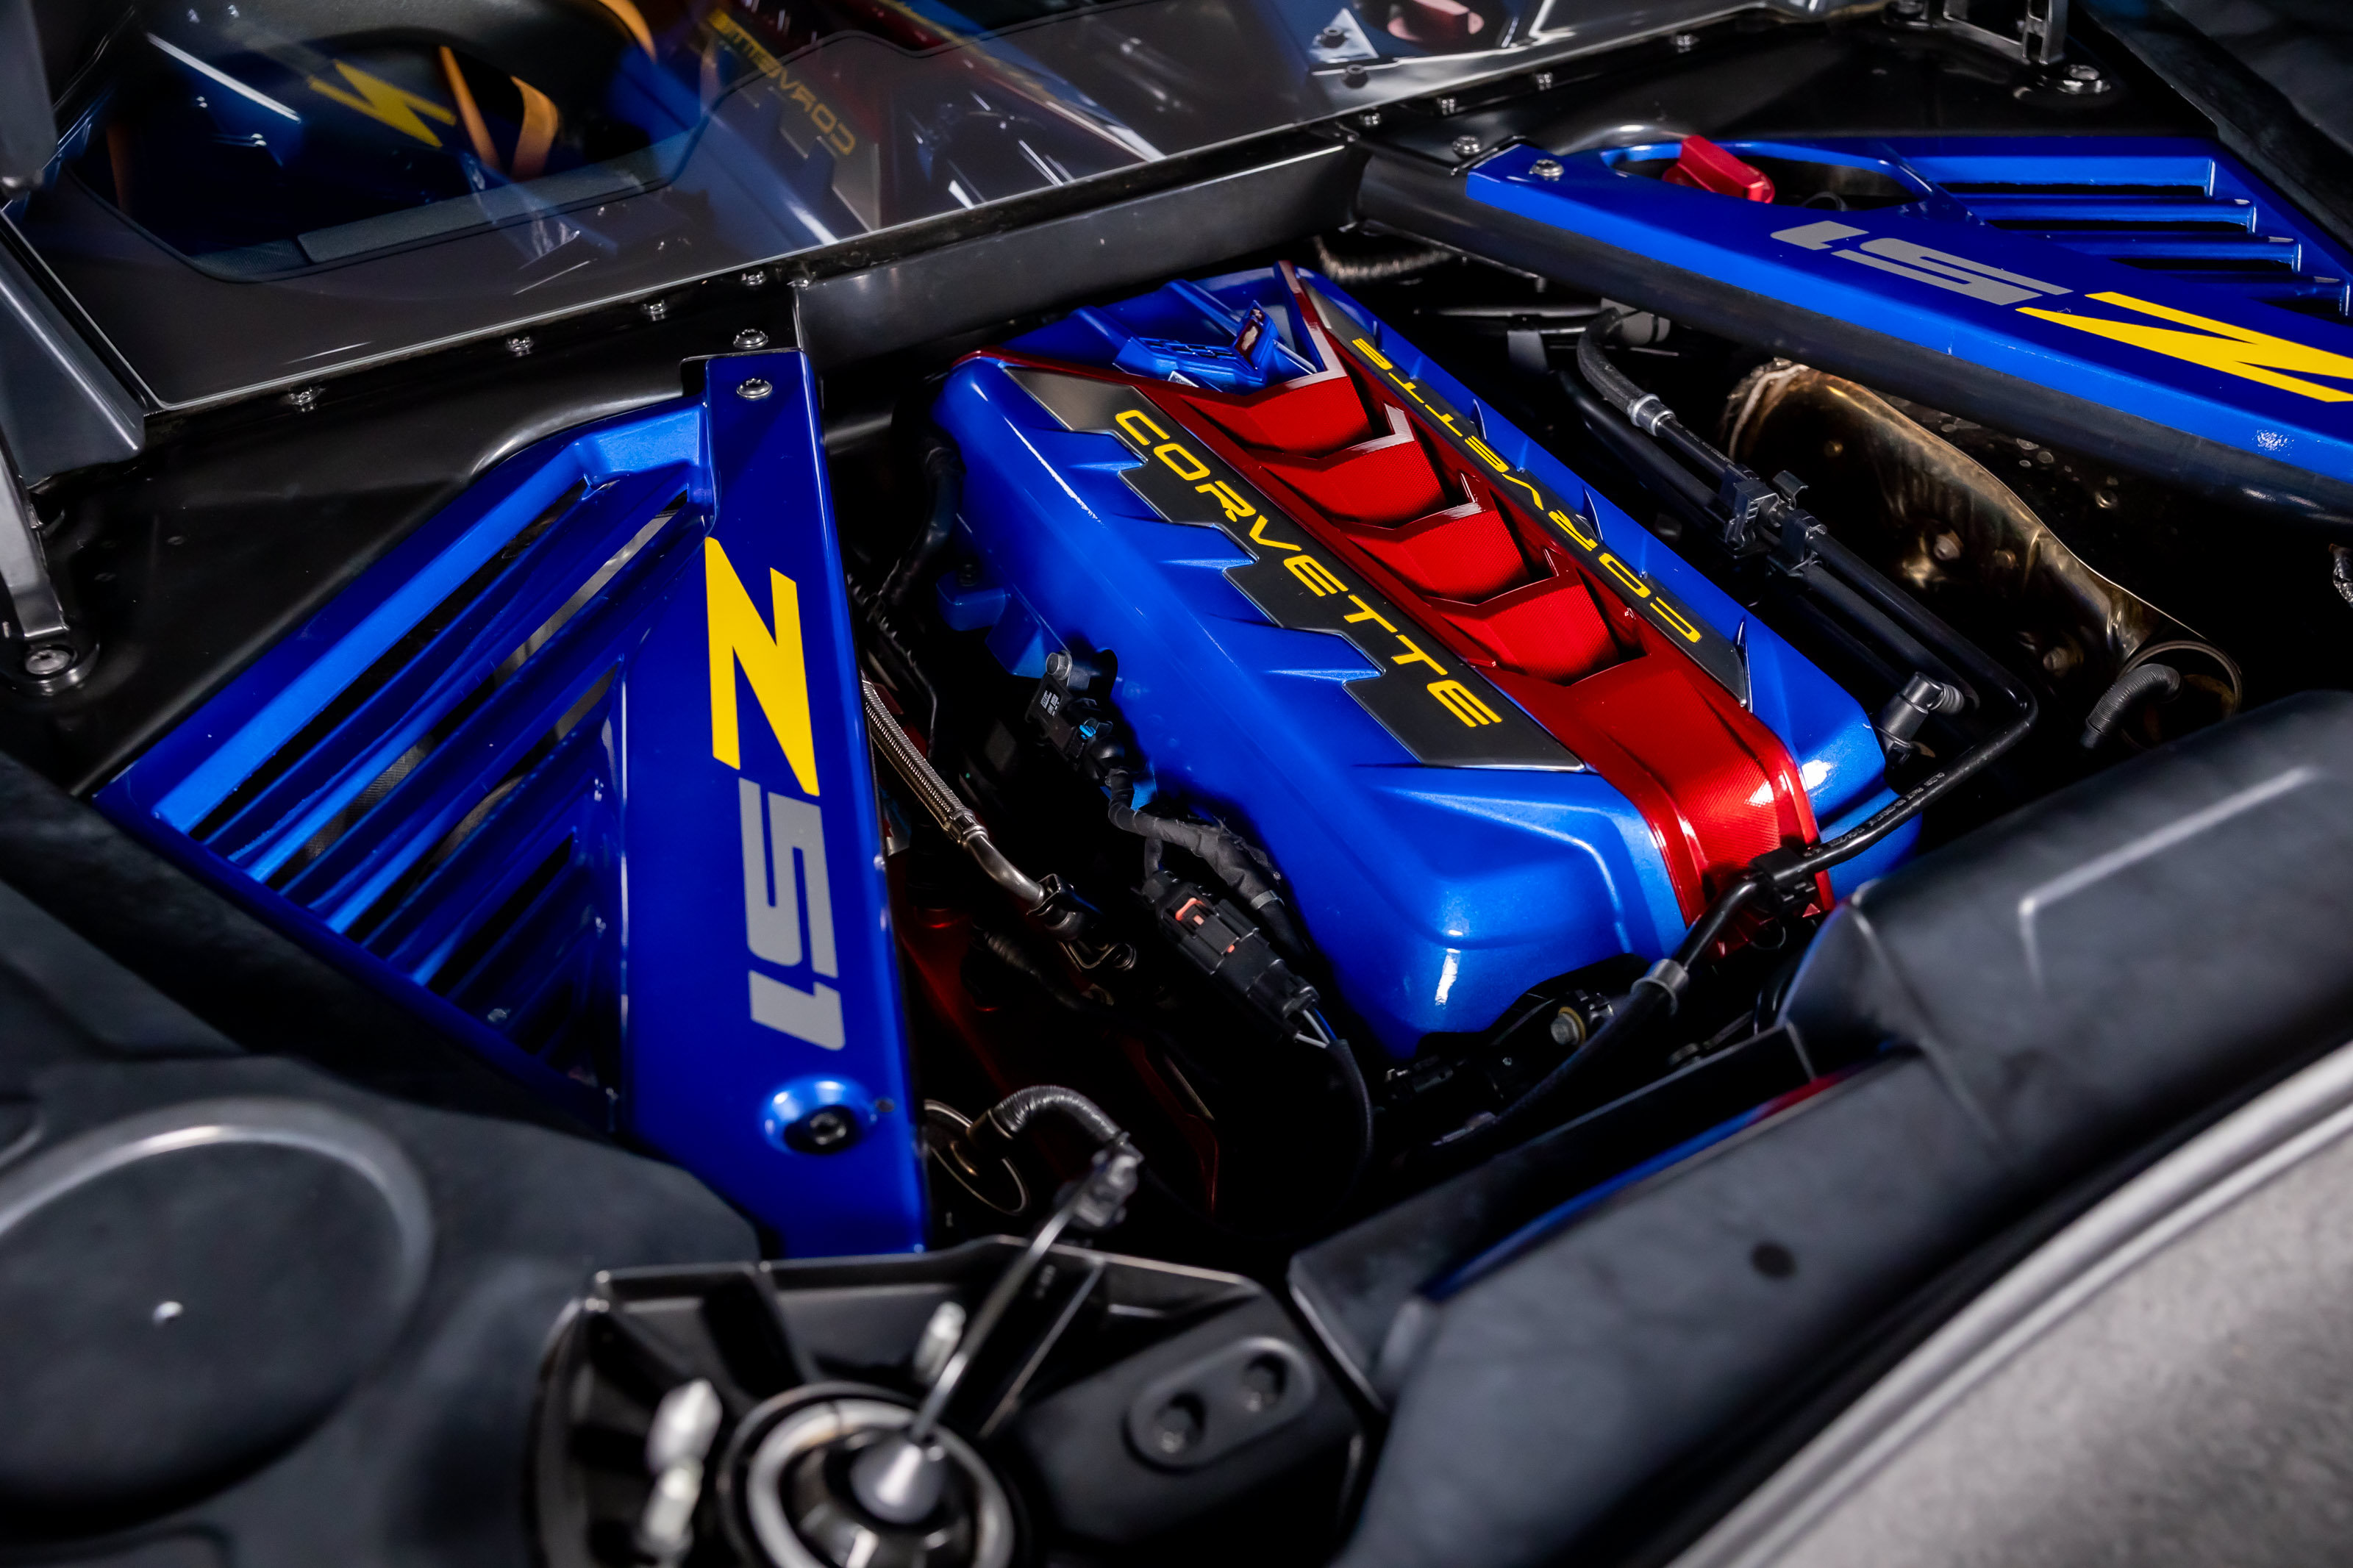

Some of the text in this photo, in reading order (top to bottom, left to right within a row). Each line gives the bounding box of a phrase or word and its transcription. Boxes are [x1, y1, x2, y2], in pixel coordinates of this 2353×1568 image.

[1115, 409, 1503, 728] CORVETTE
[1352, 337, 1702, 644] CORVETTE
[704, 537, 846, 1051] Z51
